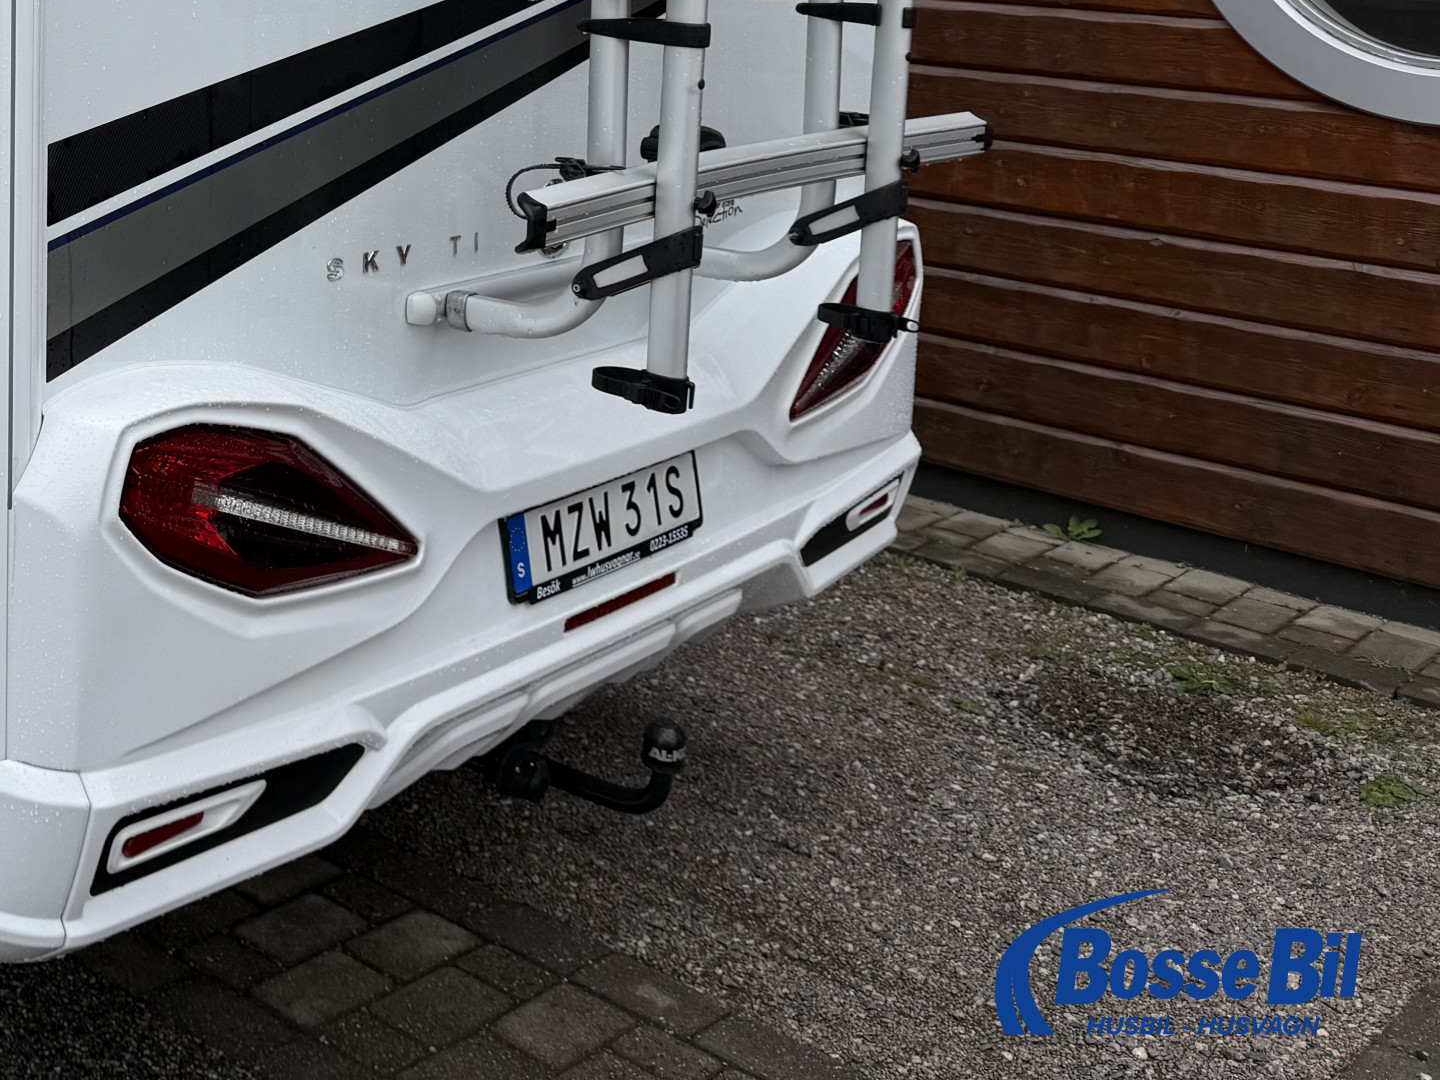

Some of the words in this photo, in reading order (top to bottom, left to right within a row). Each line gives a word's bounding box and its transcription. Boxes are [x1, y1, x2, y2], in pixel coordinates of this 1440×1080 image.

[326, 244, 412, 282] SKY
[449, 231, 479, 257] TI
[540, 491, 613, 572] MZW
[621, 465, 684, 537] 31S
[517, 562, 526, 578] S
[536, 579, 561, 600] Besök
